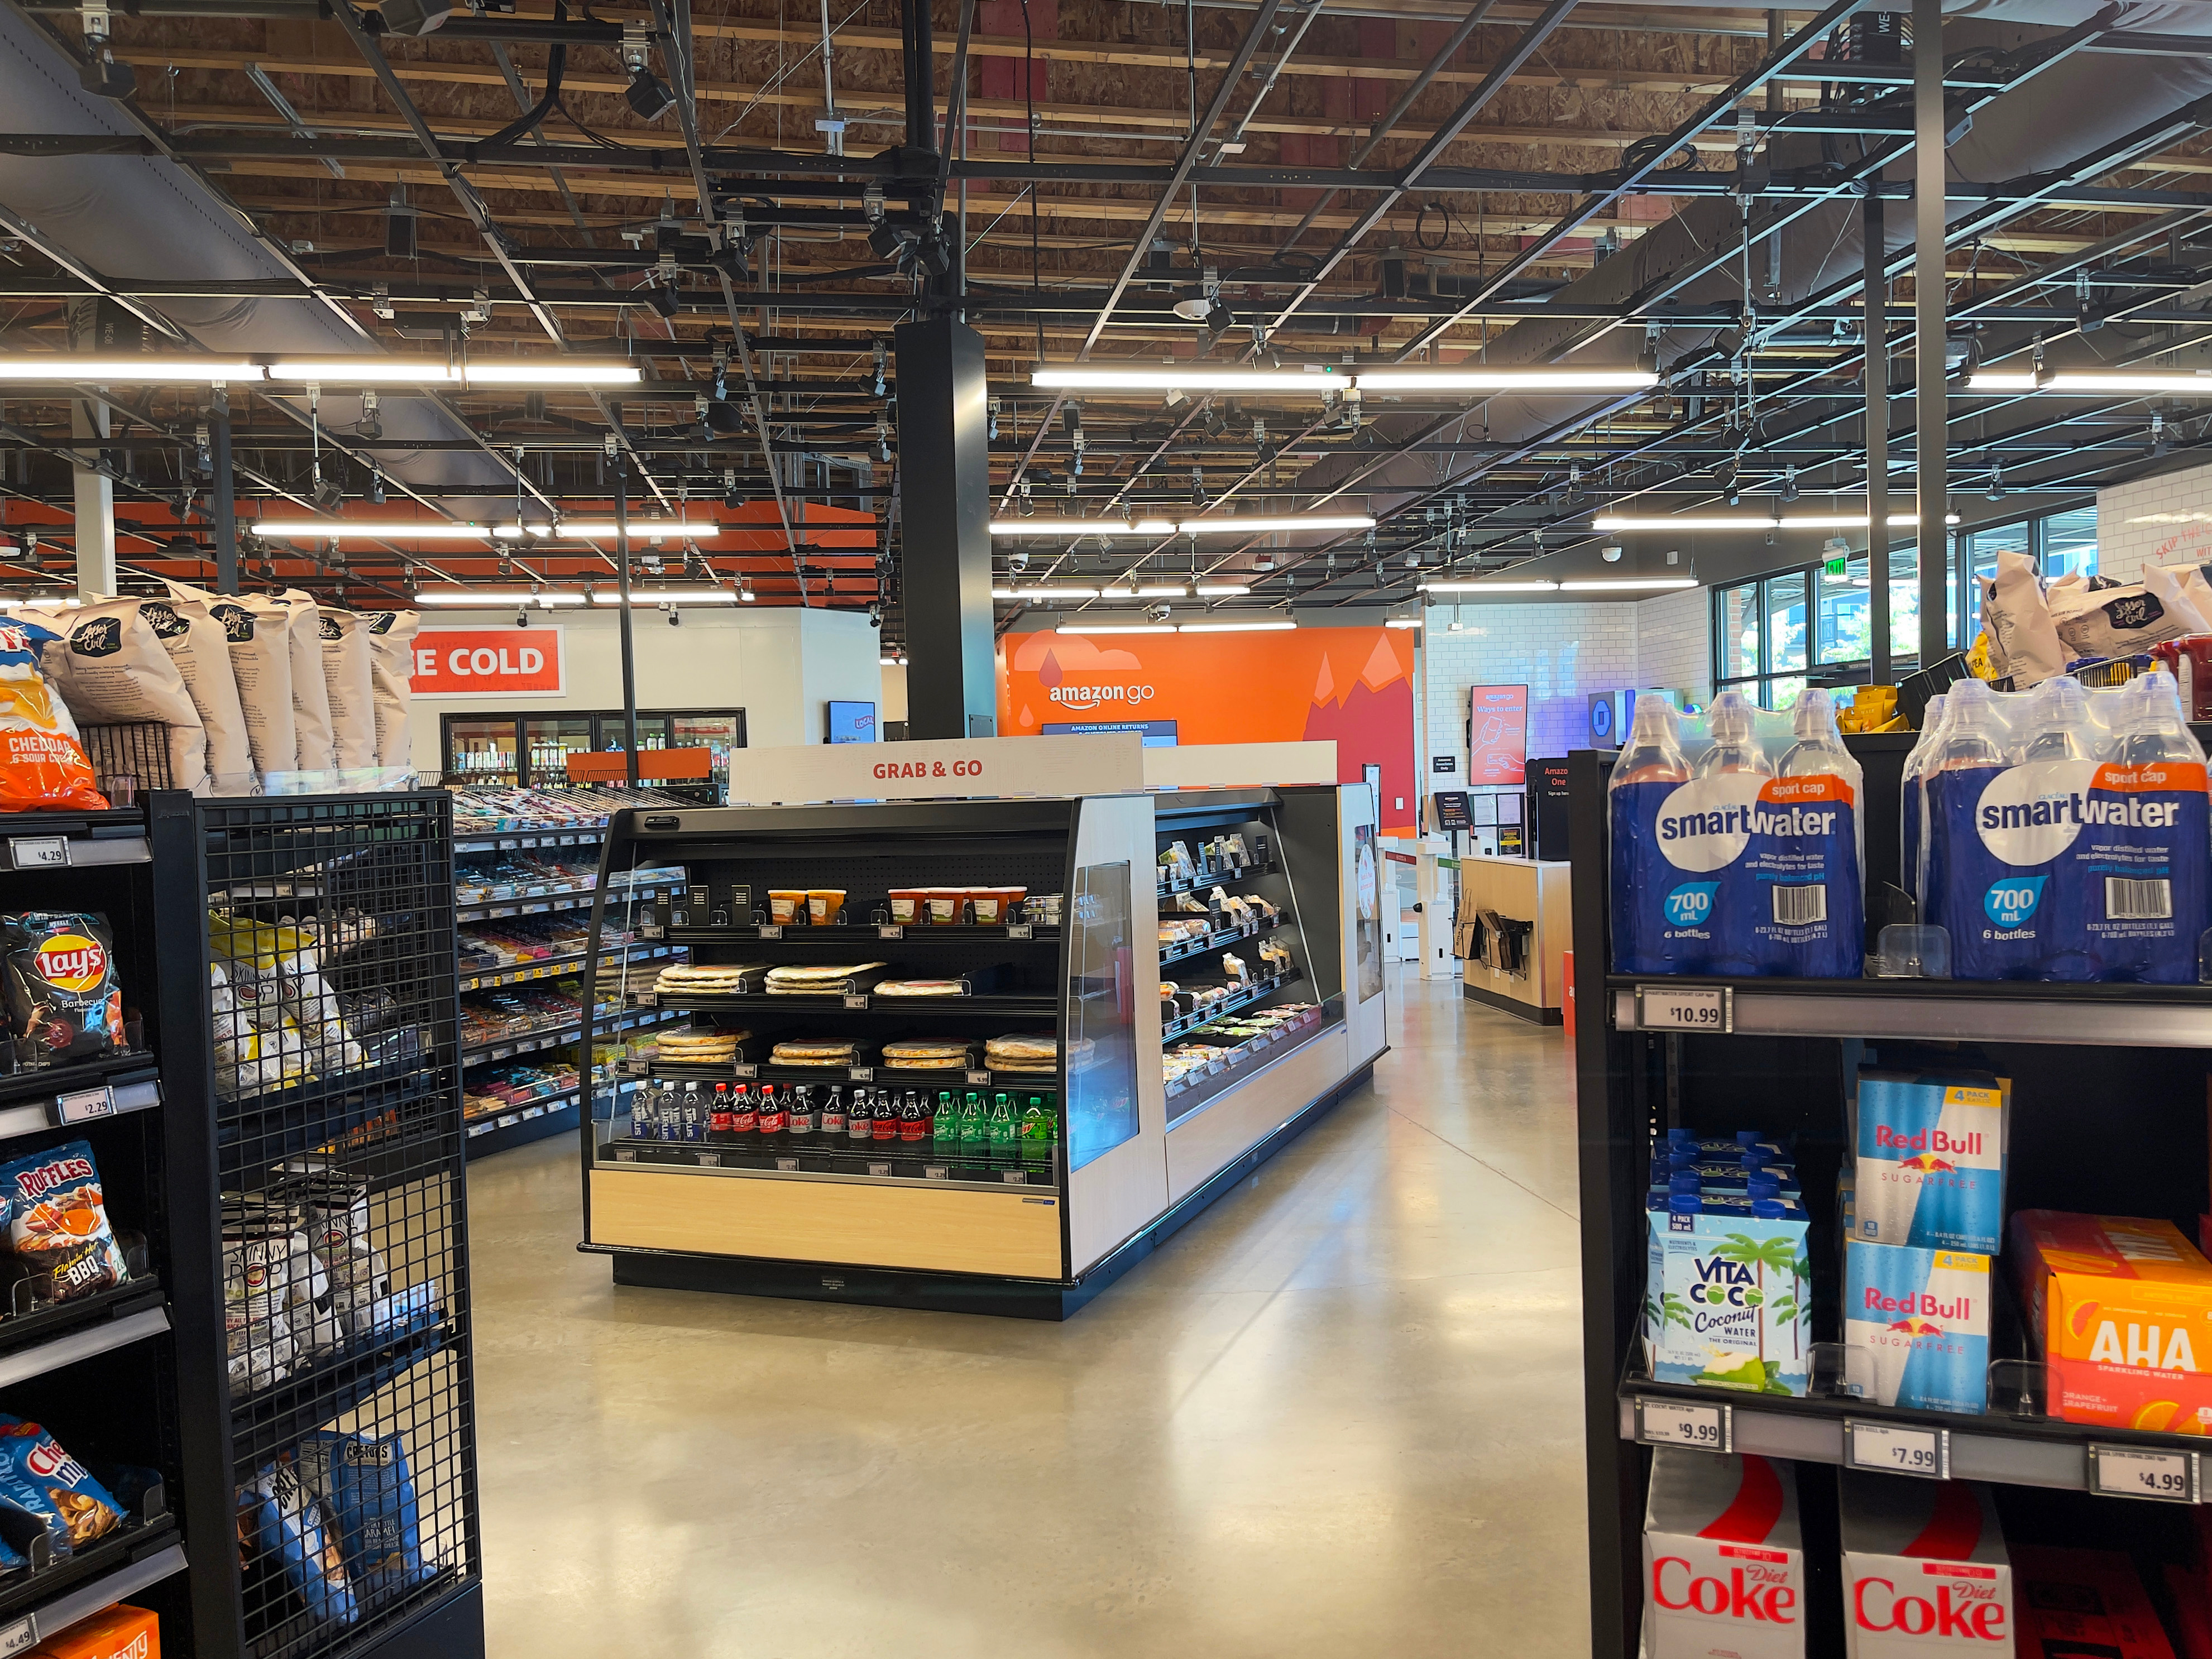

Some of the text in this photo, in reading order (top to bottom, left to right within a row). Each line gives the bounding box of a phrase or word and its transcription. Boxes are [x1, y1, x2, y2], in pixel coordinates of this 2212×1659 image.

[2156, 536, 2177, 560] SKIP
[2181, 525, 2201, 542] THE
[2197, 546, 2212, 557] WIT
[1828, 558, 1844, 575] EXIT
[76, 624, 108, 643] Lesser
[448, 648, 544, 675] COLD
[1050, 685, 1155, 706] amazon go
[856, 717, 874, 728] LOCAL
[23, 753, 46, 764] SOUR
[873, 760, 982, 779] GRAB & GO
[1544, 767, 1568, 775] Amazo
[2105, 771, 2167, 785] sport cap
[1552, 778, 1567, 786] One
[1771, 783, 1825, 796] sport cap
[1983, 793, 2180, 830] smartwater
[1662, 805, 1836, 841] smartwater
[39, 851, 61, 861] $4.29
[2091, 852, 2133, 862] electrolytes
[2113, 845, 2143, 853] distilled
[1759, 861, 1796, 871] electrolytes
[1813, 872, 1825, 881] pH
[1670, 892, 1708, 913] 700
[1990, 889, 2034, 910] 700
[1680, 910, 1698, 920] mL
[2001, 910, 2021, 922] mL
[1674, 929, 1711, 939] bottles
[1983, 928, 2036, 941] 6 bottles
[41, 946, 102, 979] Lay's
[61, 998, 104, 1008] Barbecue
[1670, 1007, 1718, 1023] $10.99
[1954, 1090, 1965, 1101] 4
[85, 1101, 108, 1114] $2.29
[822, 1114, 844, 1125] Coke
[1876, 1125, 1981, 1155] Red Bull
[16, 1158, 94, 1198] RUFFLES
[1881, 1172, 1976, 1190] SUGARFREE
[1678, 1215, 1691, 1224] PACK
[54, 1241, 98, 1279] Flamin' Hot
[230, 1244, 286, 1263] SKINNY
[1942, 1255, 1953, 1265] 4
[67, 1255, 99, 1286] BBQ
[1693, 1256, 1755, 1286] VITA
[1689, 1283, 1765, 1307] COCO
[1865, 1287, 1970, 1320] Red Bull
[1694, 1304, 1759, 1334] Coconut
[1723, 1326, 1756, 1337] WATER
[1722, 1338, 1757, 1347] ORIGINAL
[1870, 1335, 1964, 1355] SUGARFREE
[2089, 1320, 2196, 1373] AHA
[2097, 1364, 2184, 1380] SPARKLING WATER
[1723, 1380, 1759, 1389] CONCENTRATE
[1679, 1423, 1718, 1441] $9.99
[29, 1441, 67, 1475] Che
[1892, 1447, 1934, 1467] $7.99
[2139, 1472, 2184, 1492] $4.99
[1746, 1564, 1788, 1584] Diet
[1653, 1556, 1796, 1624] Coke
[1952, 1581, 1996, 1600] Diet
[1854, 1576, 2006, 1641] Coke
[6, 1631, 30, 1649] $4.49
